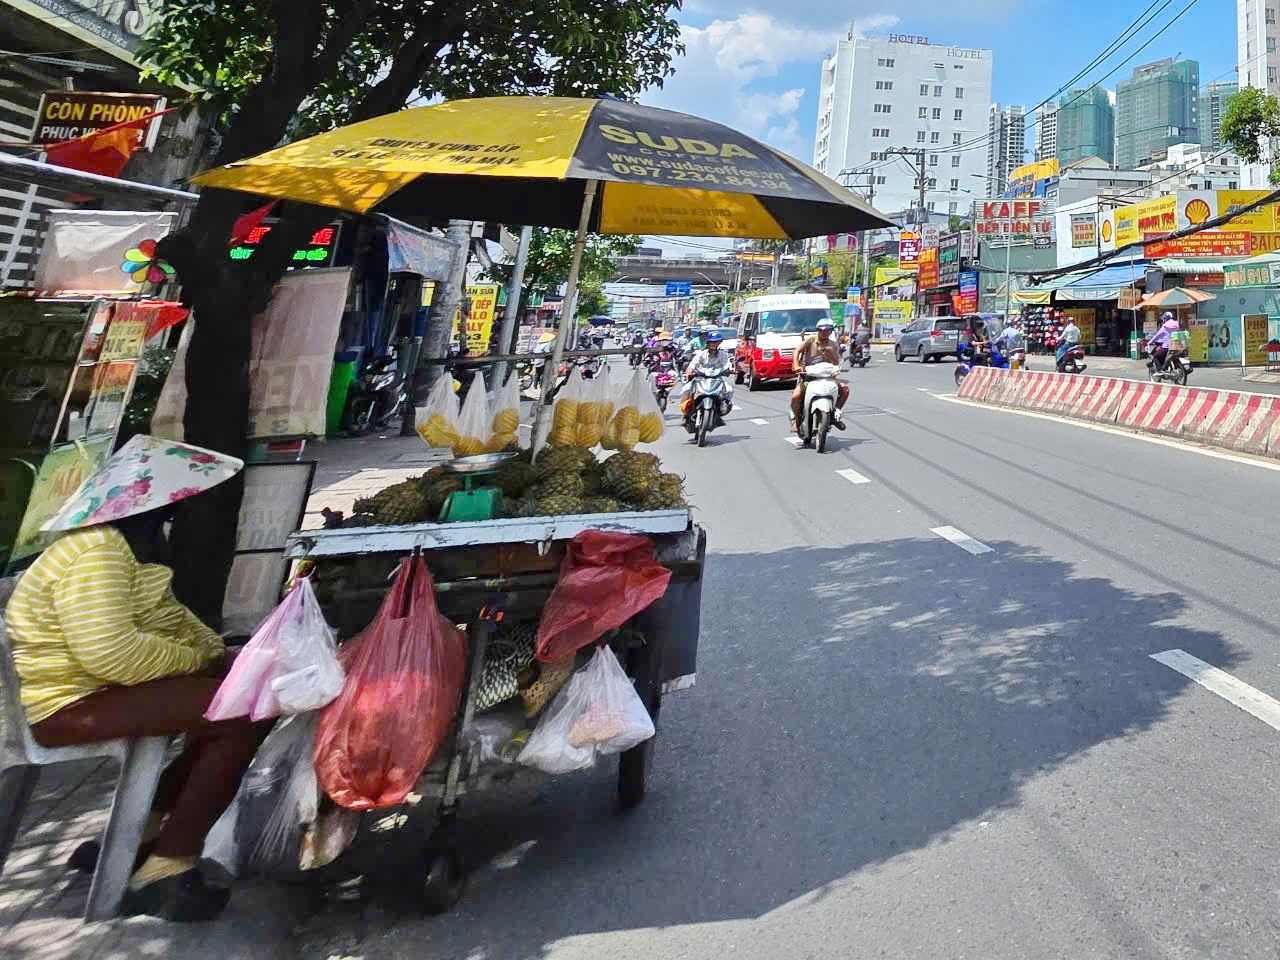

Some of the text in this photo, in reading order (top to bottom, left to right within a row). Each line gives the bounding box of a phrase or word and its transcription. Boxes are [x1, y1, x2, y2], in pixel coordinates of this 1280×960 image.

[888, 33, 931, 46] HOTEL
[947, 48, 983, 60] HOTEL
[438, 140, 481, 153] CUNG
[599, 123, 759, 160] SUDA
[640, 148, 737, 165] COFFEE
[607, 151, 786, 181] www.sudacoffee.vn
[983, 201, 1040, 219] KAFF
[475, 296, 492, 309] DÉP
